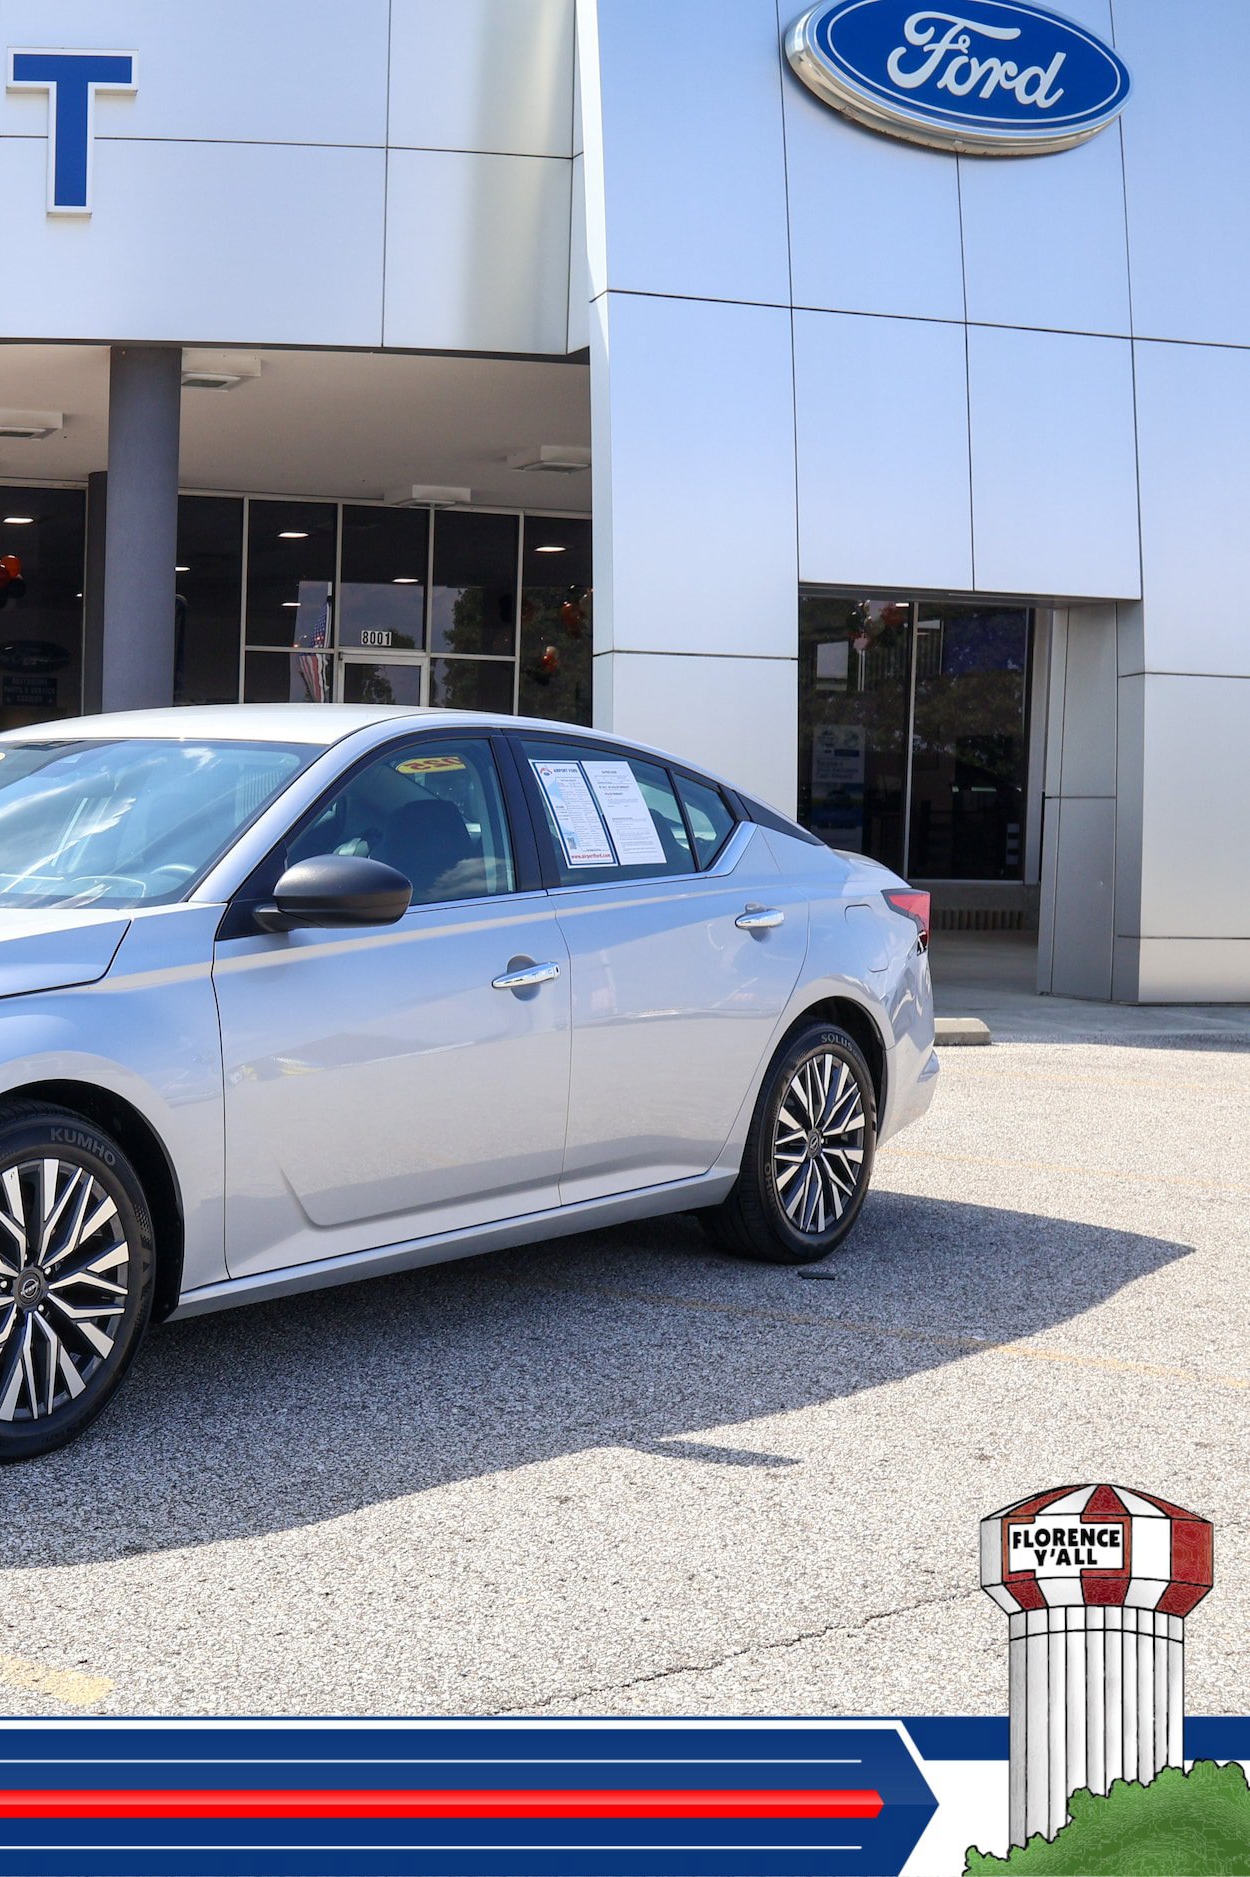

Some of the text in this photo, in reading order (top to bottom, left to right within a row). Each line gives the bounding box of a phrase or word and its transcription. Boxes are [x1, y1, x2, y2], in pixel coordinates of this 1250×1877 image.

[886, 10, 1067, 109] Ford
[362, 631, 390, 645] 8001
[821, 1033, 852, 1051] SOLUS
[50, 1127, 116, 1166] KUMHO
[764, 1162, 781, 1218] UMHO
